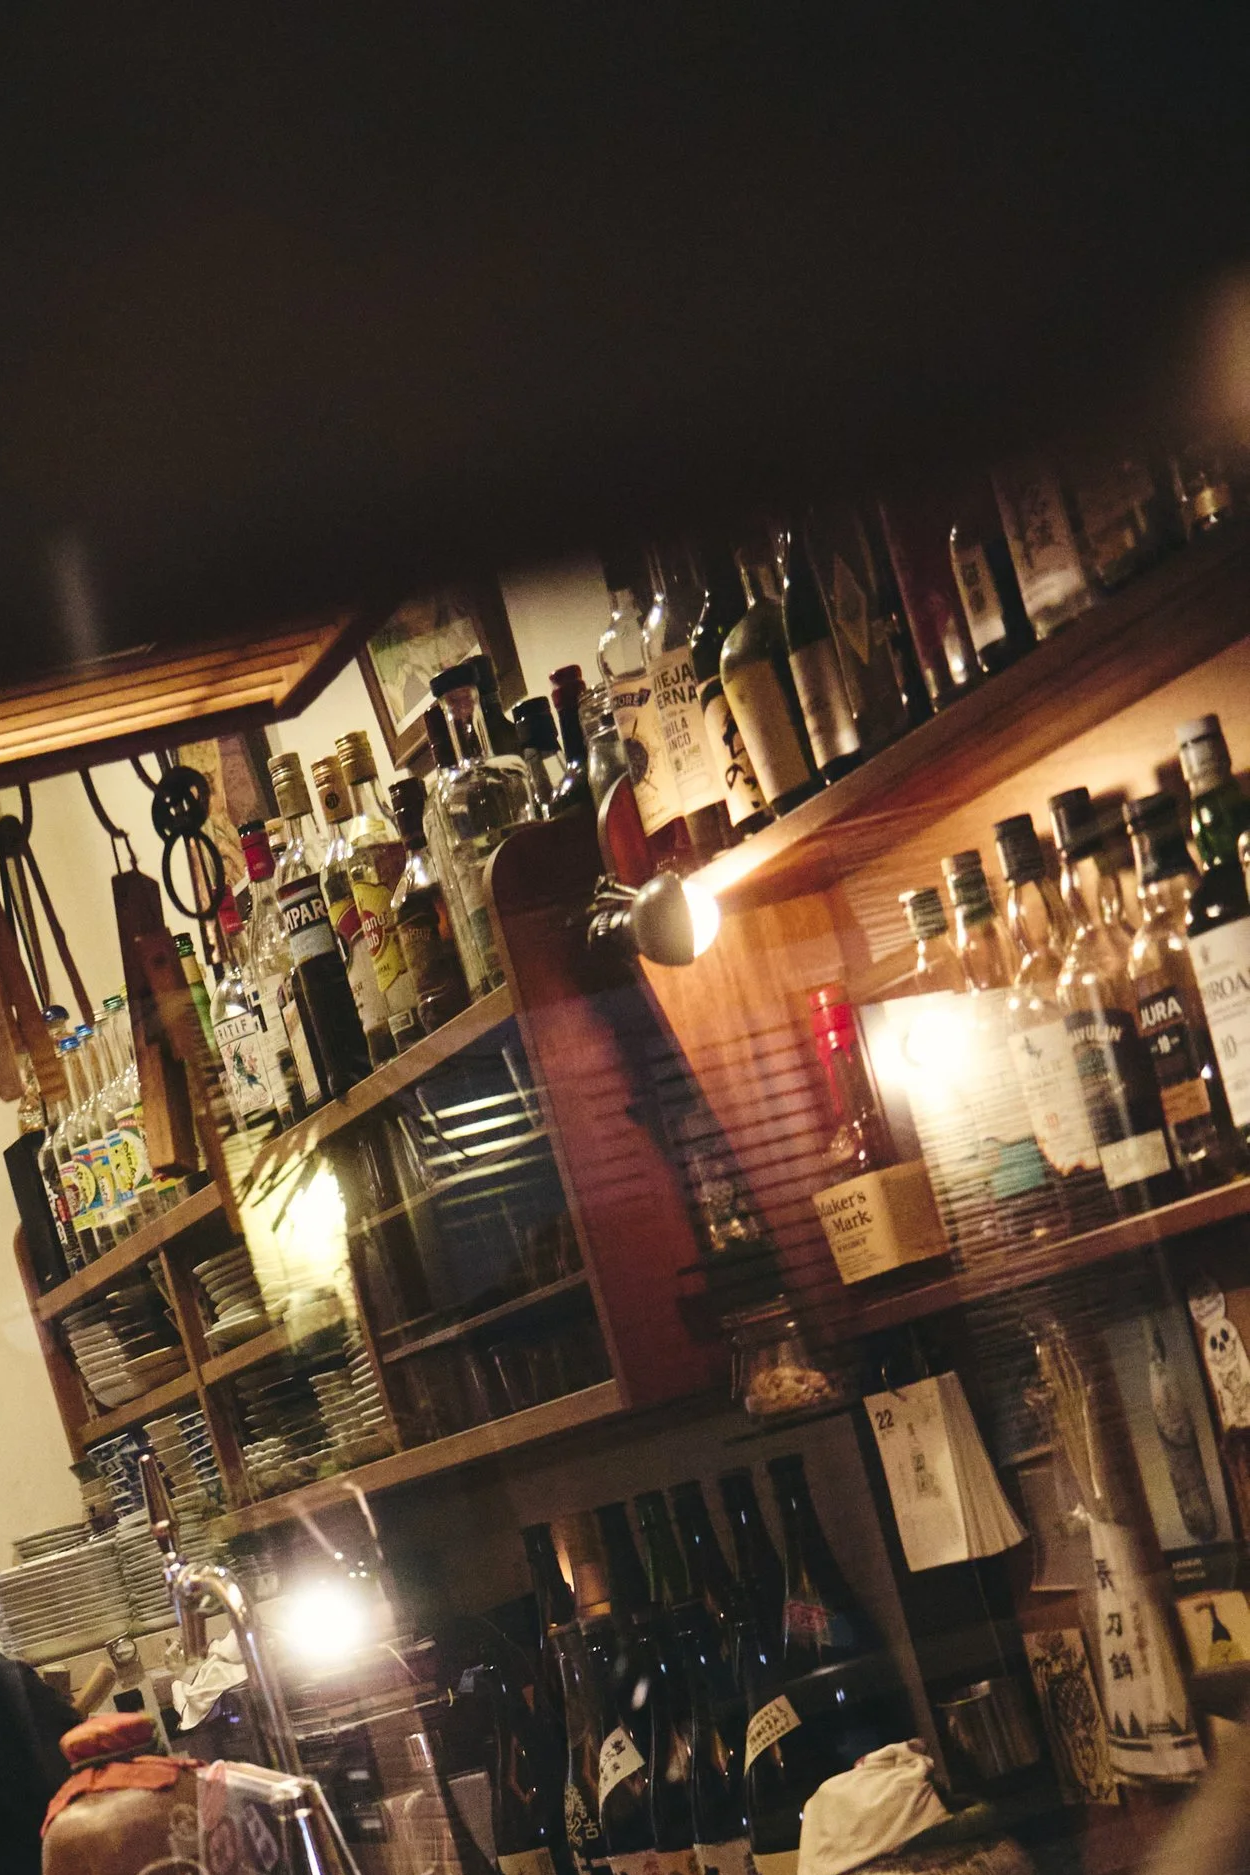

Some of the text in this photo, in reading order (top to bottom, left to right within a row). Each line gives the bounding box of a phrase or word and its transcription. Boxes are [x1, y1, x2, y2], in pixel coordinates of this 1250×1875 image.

[1140, 996, 1183, 1030] JURA
[832, 1211, 873, 1232] Mark
[875, 1409, 895, 1430] 22
